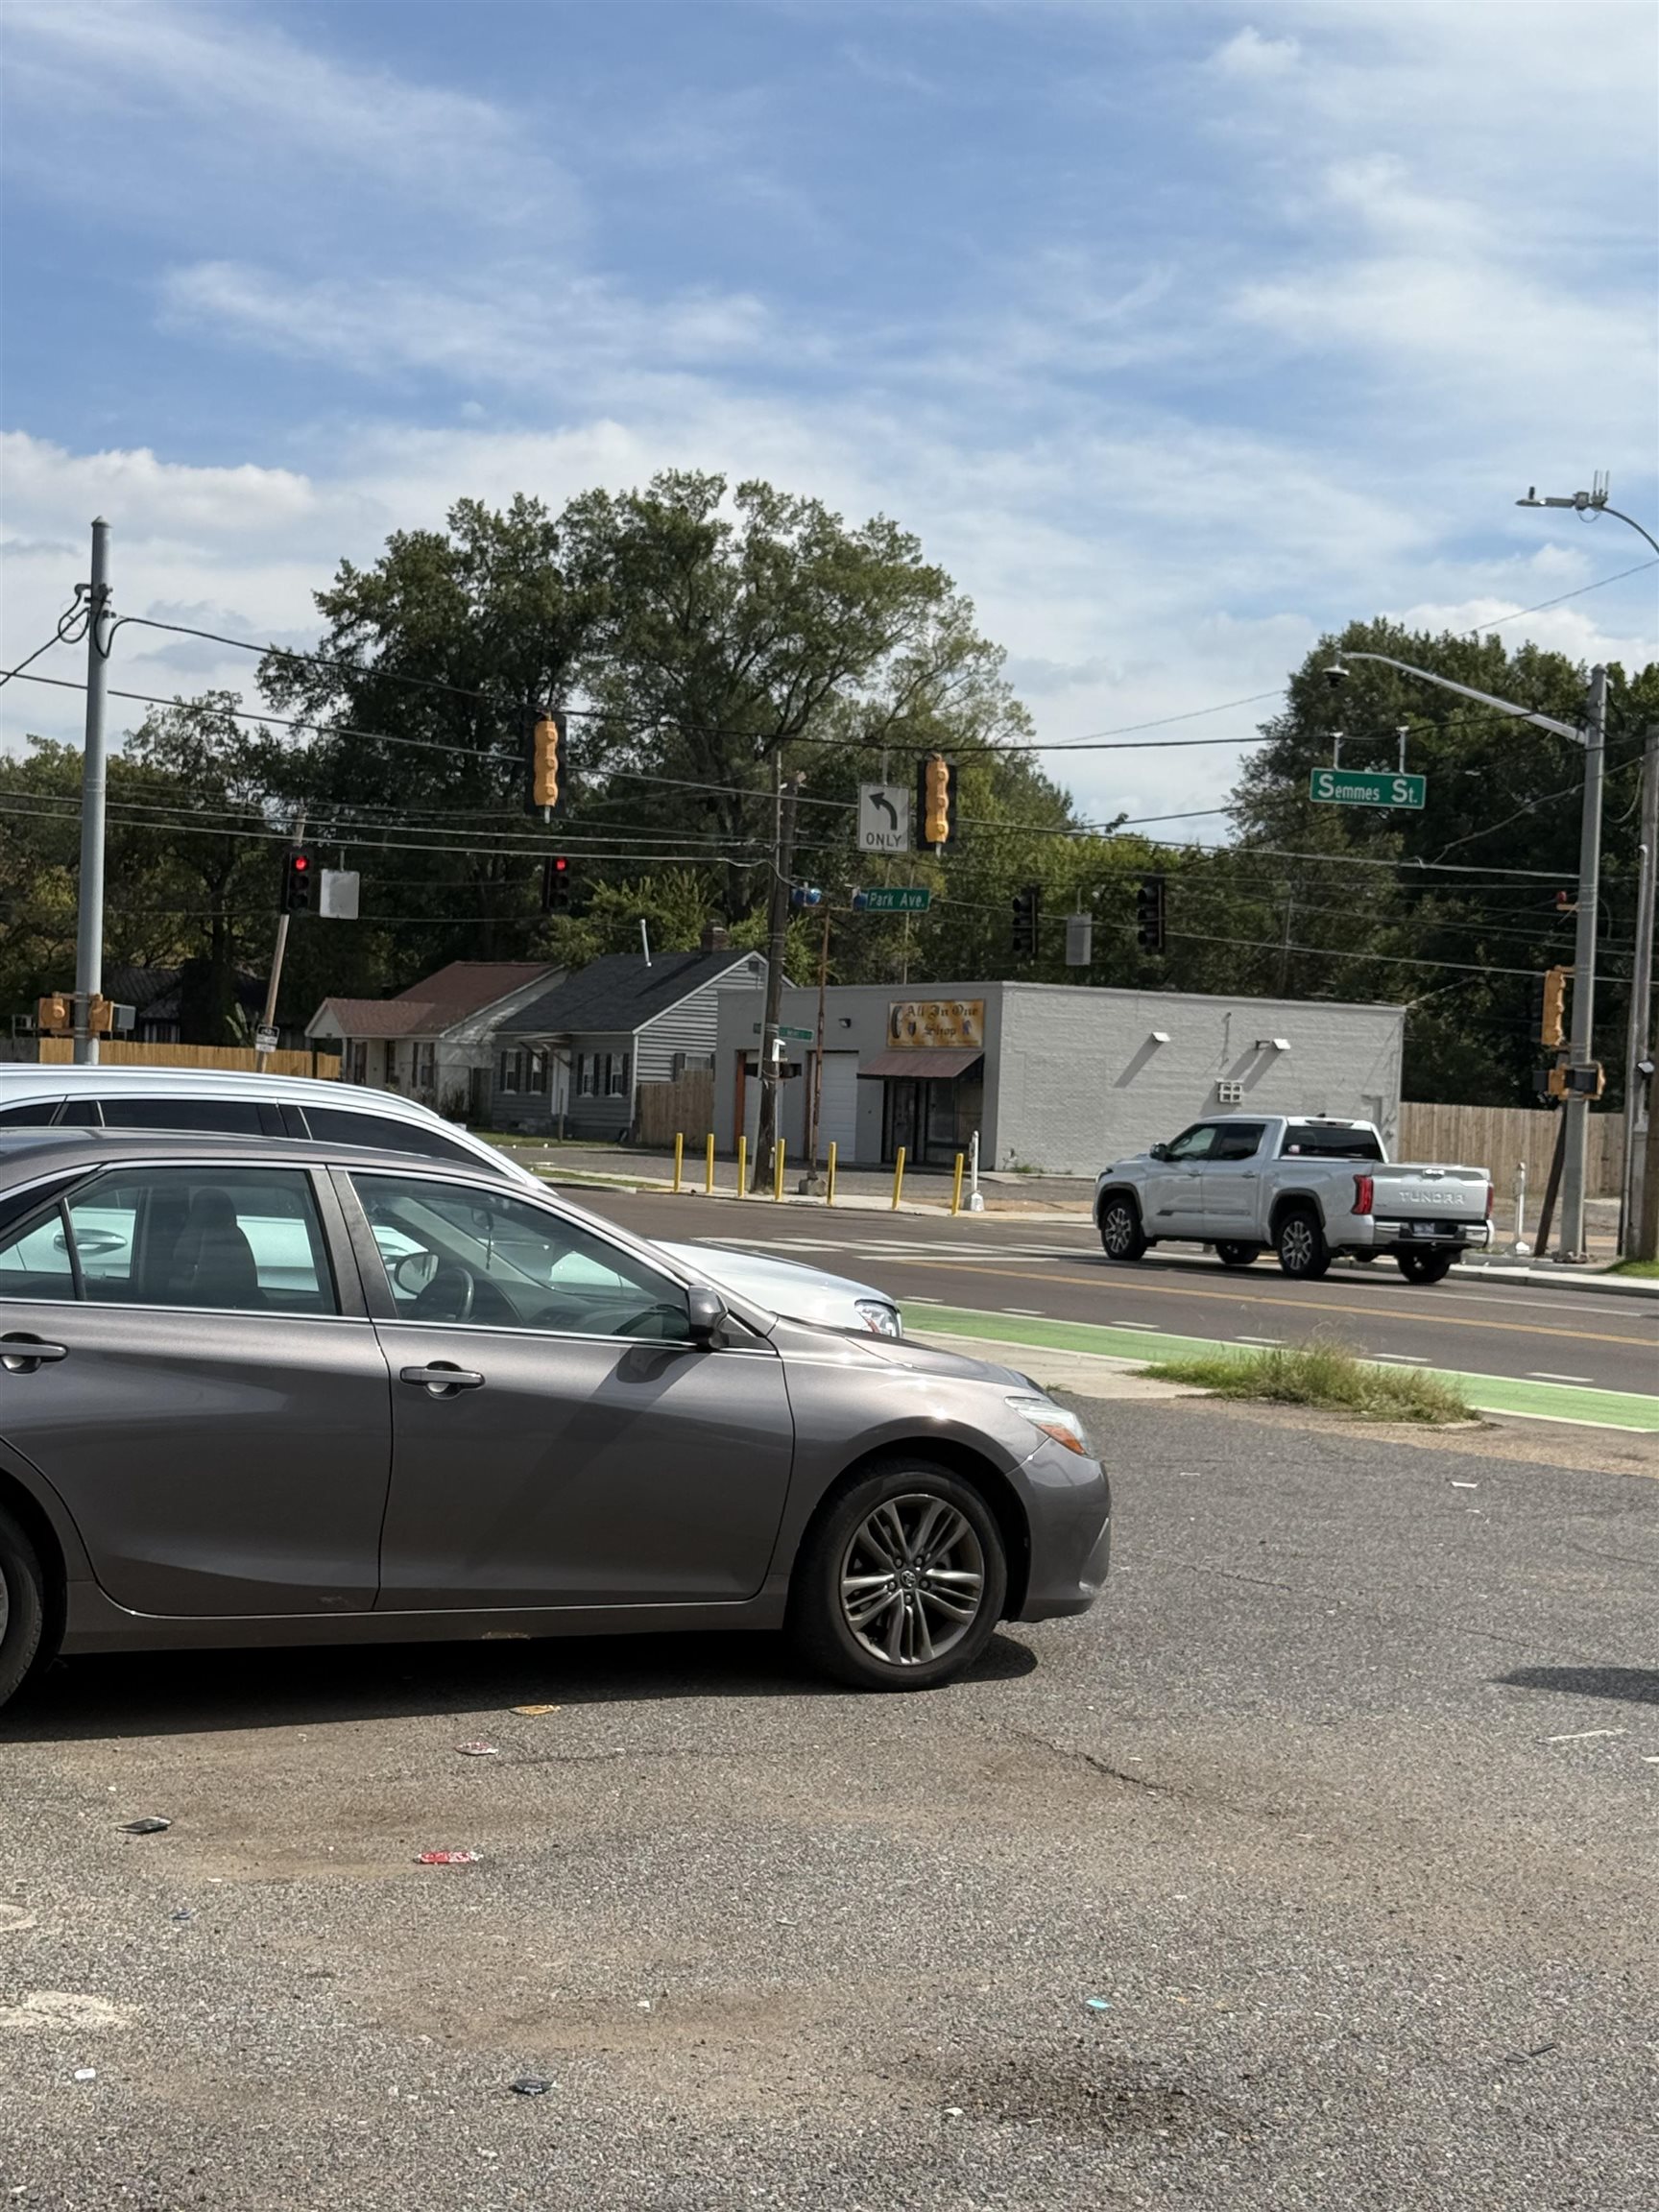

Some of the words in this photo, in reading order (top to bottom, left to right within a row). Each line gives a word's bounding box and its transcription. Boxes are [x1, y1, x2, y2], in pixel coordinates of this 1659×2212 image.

[1317, 773, 1381, 802] Semmes
[1391, 778, 1418, 804] St.
[866, 831, 902, 847] ONLY
[869, 892, 894, 907] Park
[900, 892, 926, 907] Ave.
[1399, 1191, 1465, 1206] TUNDRA
